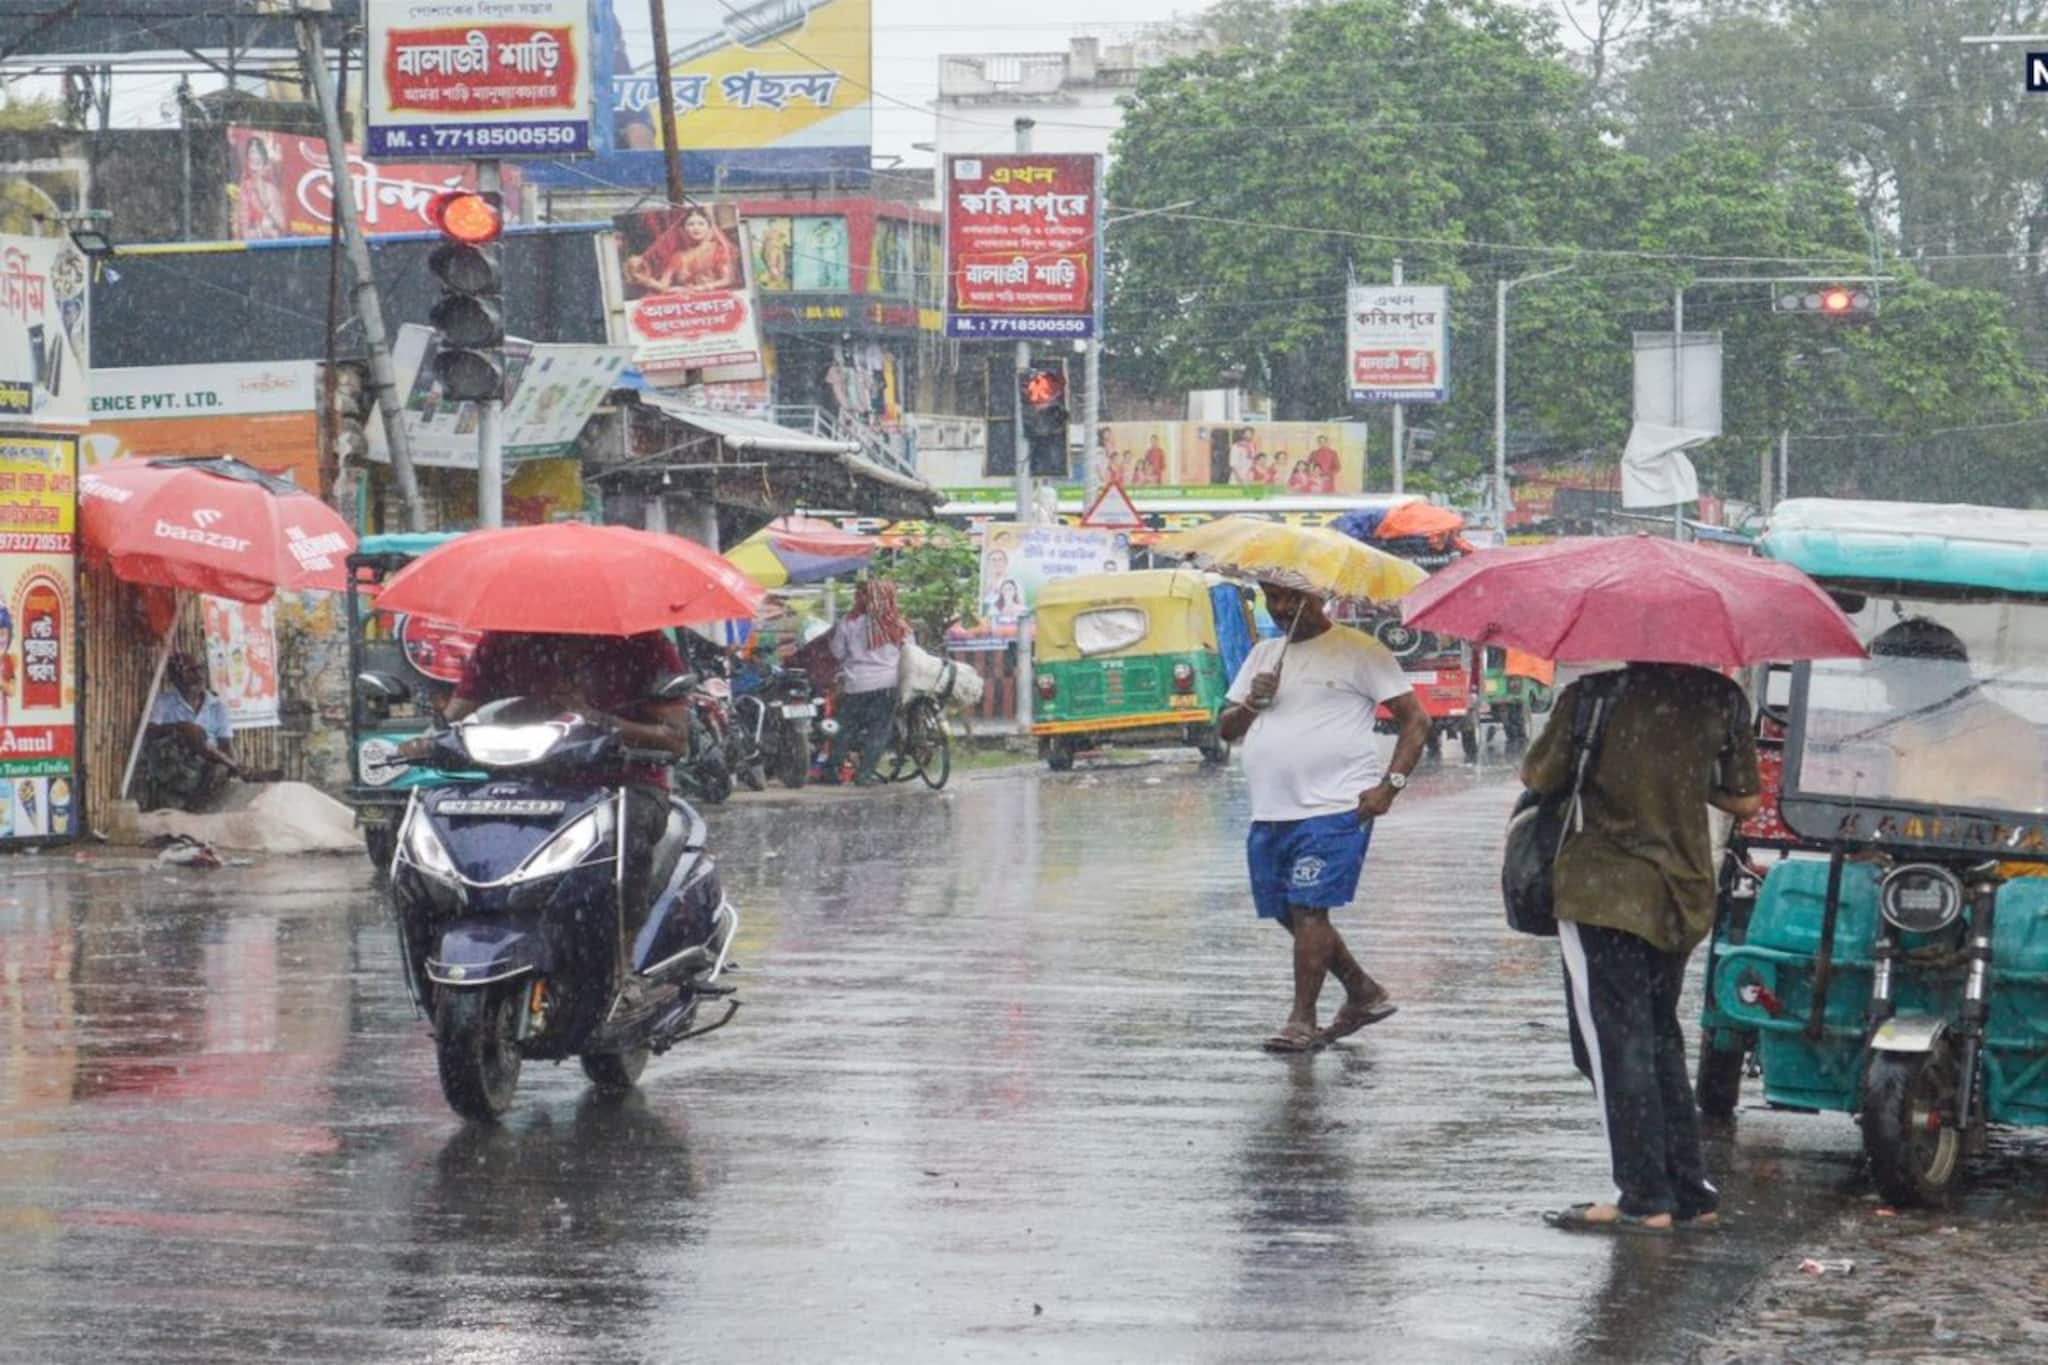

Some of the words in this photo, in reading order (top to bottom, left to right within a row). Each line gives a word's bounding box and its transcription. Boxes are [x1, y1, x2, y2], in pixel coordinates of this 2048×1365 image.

[396, 29, 490, 77] বালাজী
[497, 31, 560, 78] শাড়ি
[721, 68, 841, 111] পছন্দ
[385, 130, 414, 148] M.
[433, 126, 577, 146] 7718500550
[988, 165, 1057, 185] এখন
[958, 186, 1089, 224] করিমপুরে
[965, 255, 1029, 285] বালাজী
[1034, 258, 1076, 289] শাড়ি
[989, 317, 1085, 331] 7718500550
[1353, 307, 1438, 330] করিমপুরে
[140, 393, 181, 410] PVT.
[185, 391, 223, 408] LTD.
[153, 518, 252, 552] baazar
[0, 728, 53, 752] Amul
[44, 760, 70, 774] India
